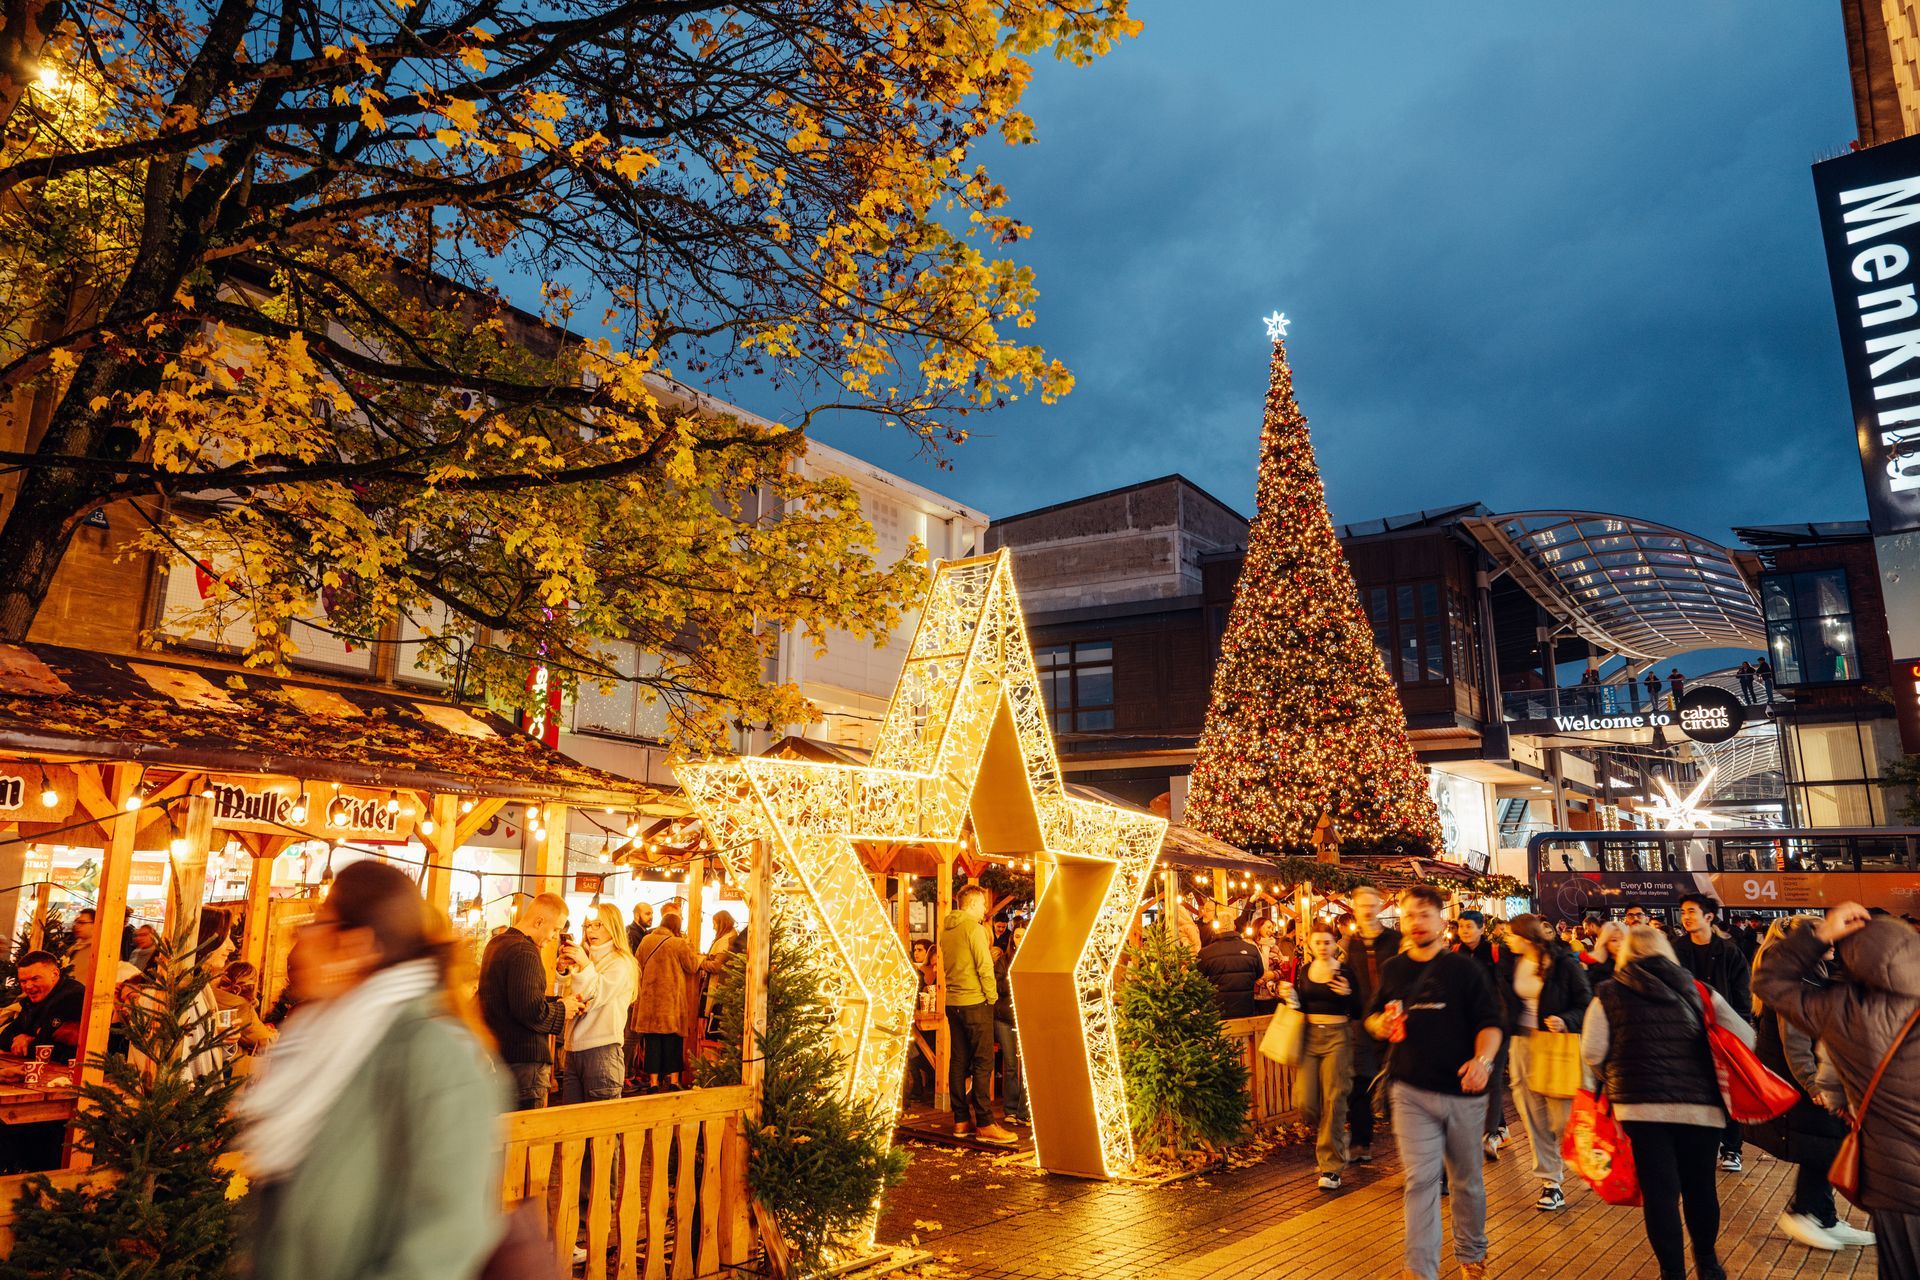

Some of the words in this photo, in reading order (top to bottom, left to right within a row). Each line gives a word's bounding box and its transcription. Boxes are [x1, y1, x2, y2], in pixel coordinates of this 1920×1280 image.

[1680, 705, 1728, 720] cabot
[1553, 714, 1643, 732] Welcome
[1649, 712, 1670, 727] to
[1681, 717, 1730, 730] circus
[213, 784, 308, 823] Mulled
[327, 797, 399, 831] Cider
[583, 881, 597, 889] SALE
[1620, 881, 1642, 891] Every
[1643, 881, 1653, 889] 10
[1654, 882, 1673, 890] mins
[1743, 879, 1778, 900] 94
